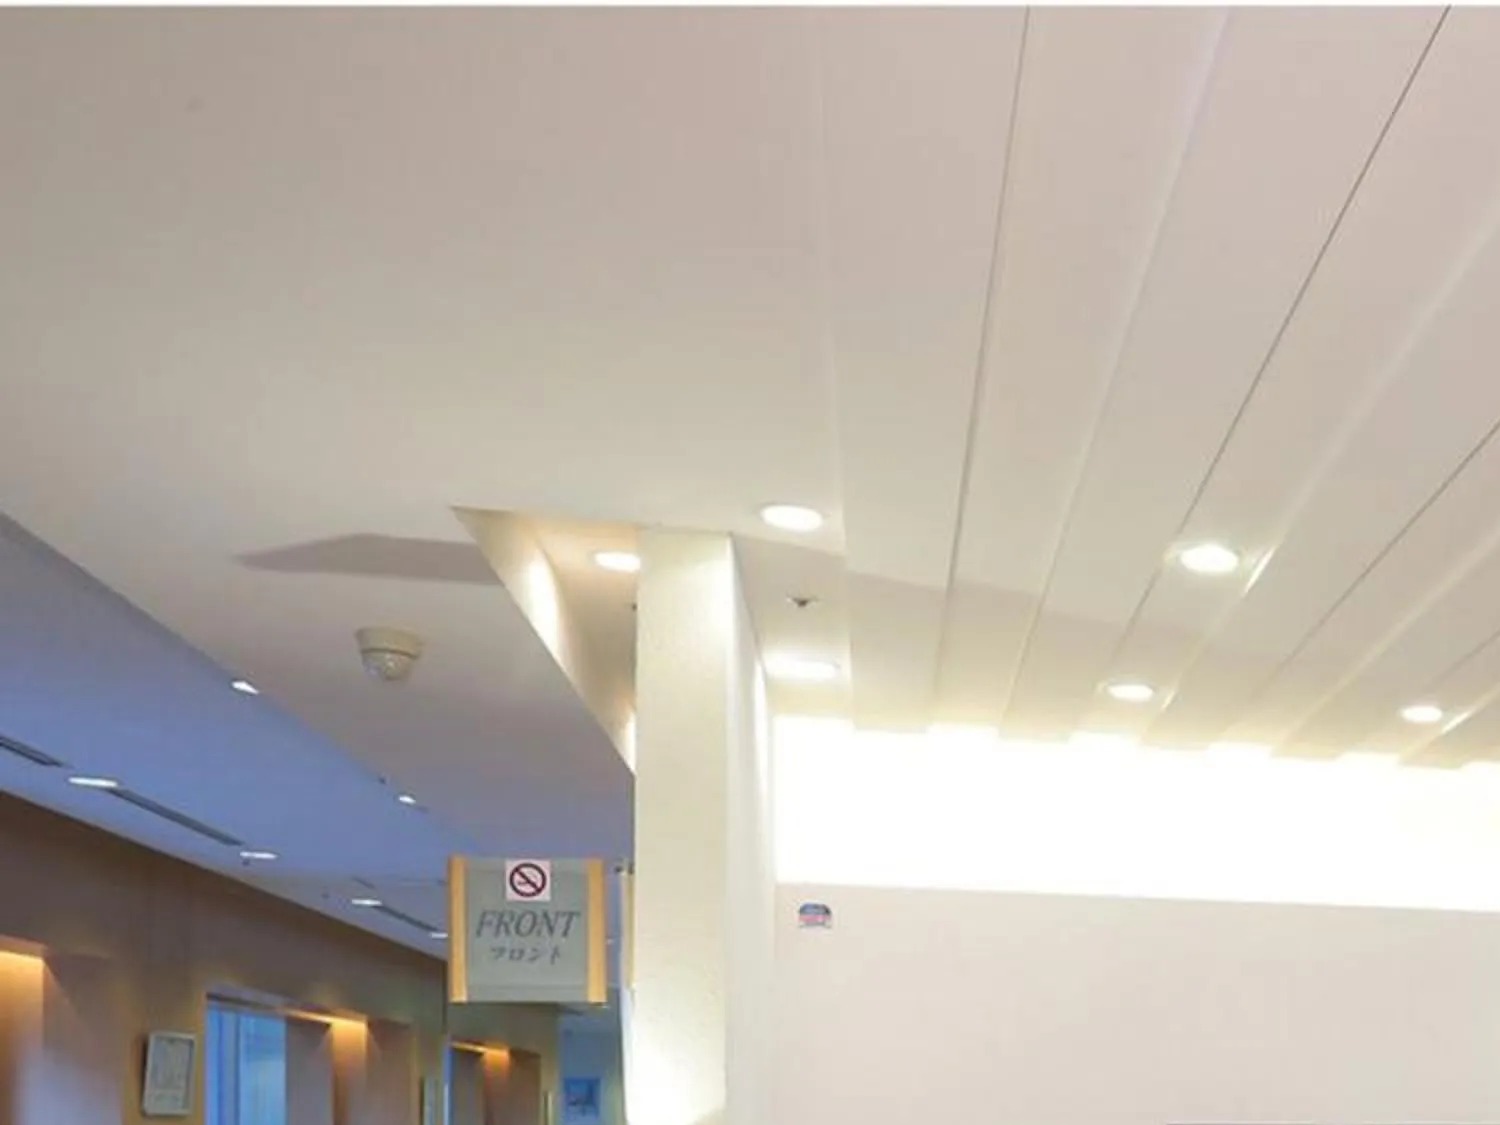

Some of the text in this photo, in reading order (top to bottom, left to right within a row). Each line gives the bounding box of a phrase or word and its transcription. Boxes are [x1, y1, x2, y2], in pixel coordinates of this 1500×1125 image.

[475, 910, 580, 938] FRONT
[490, 945, 561, 965] フロント
